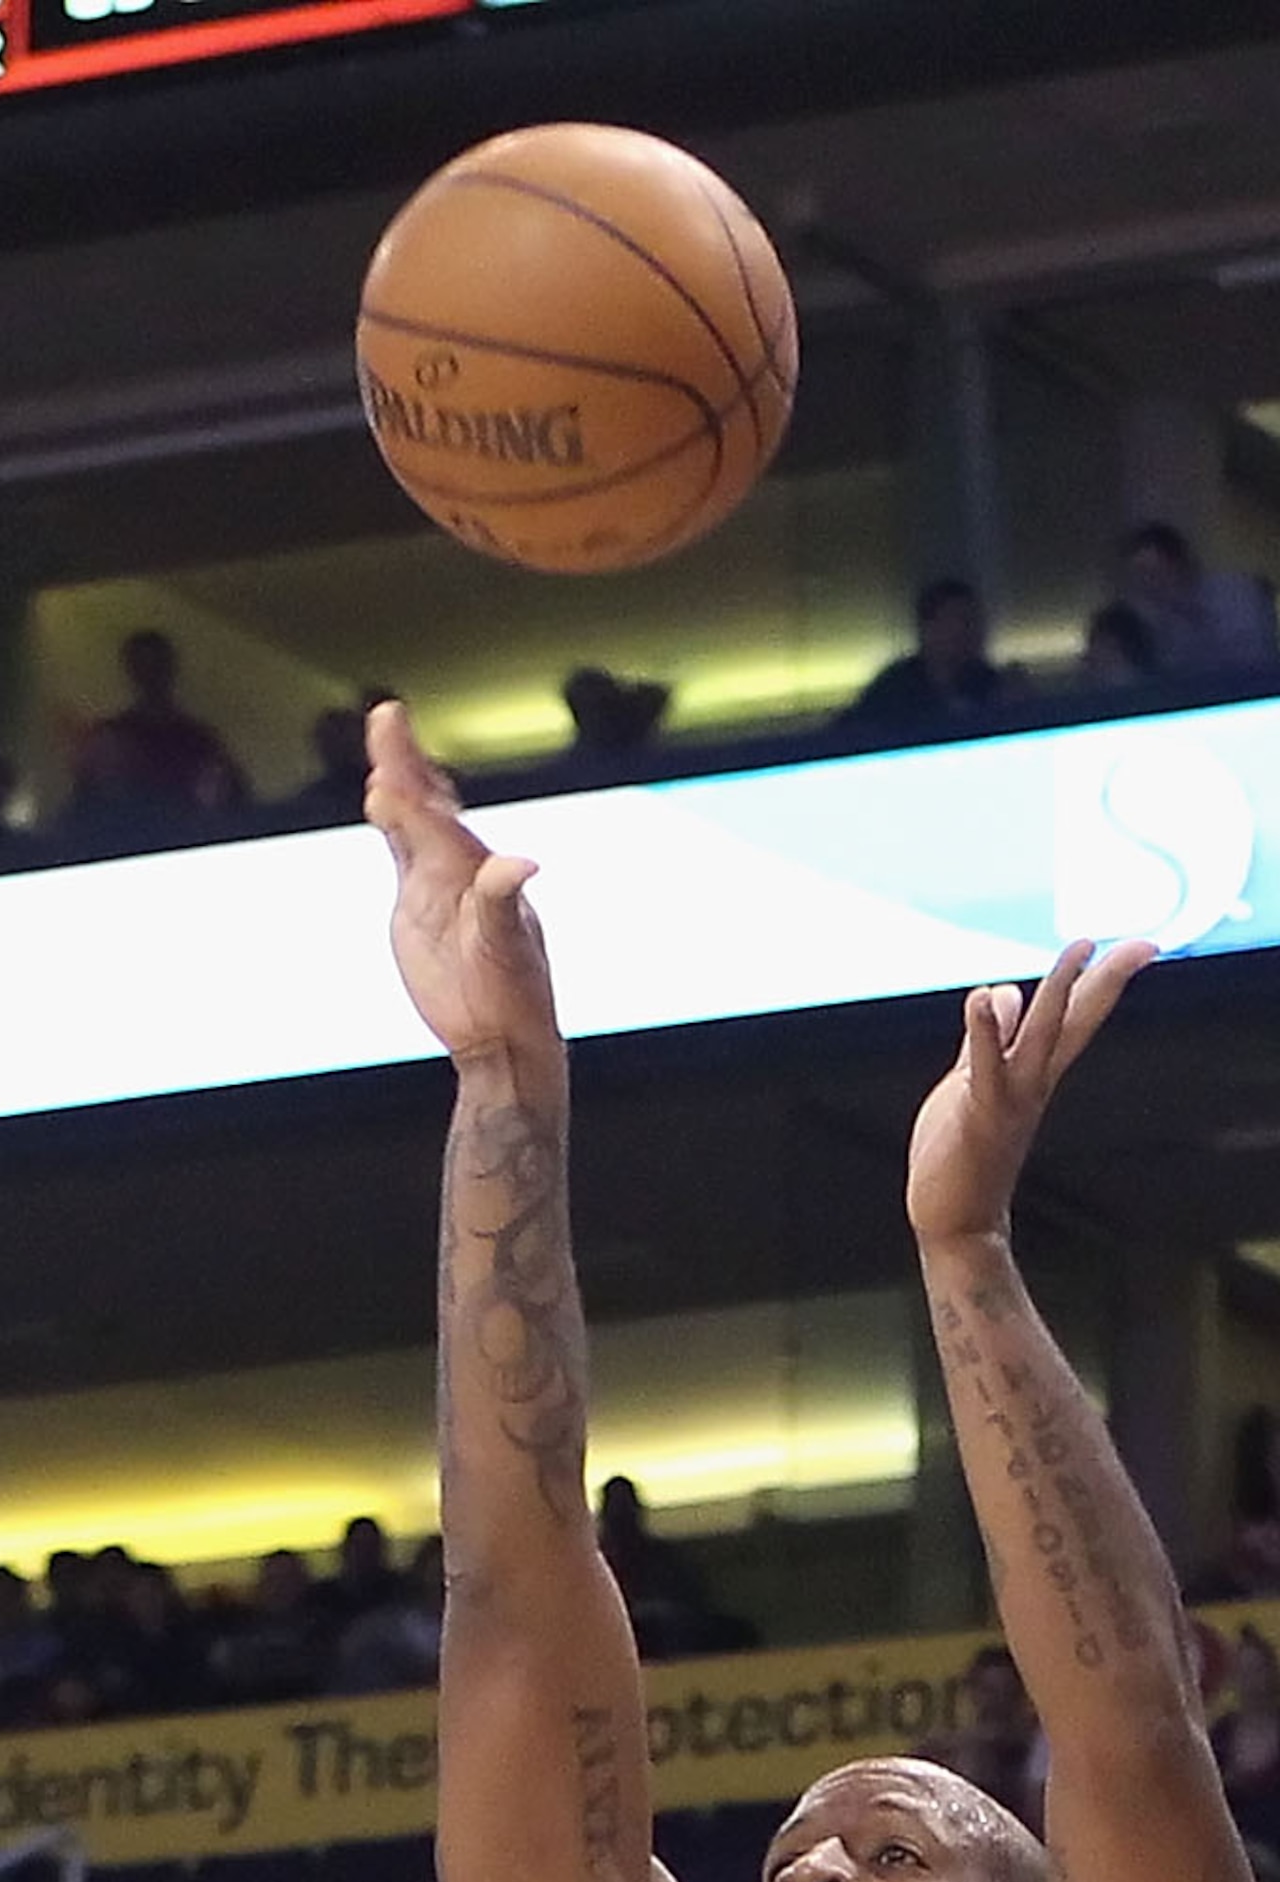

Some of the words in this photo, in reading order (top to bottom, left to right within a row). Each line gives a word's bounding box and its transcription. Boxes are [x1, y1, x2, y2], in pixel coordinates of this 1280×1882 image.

[367, 381, 586, 468] PALDING
[286, 1719, 437, 1797] The
[646, 1661, 982, 1766] otection
